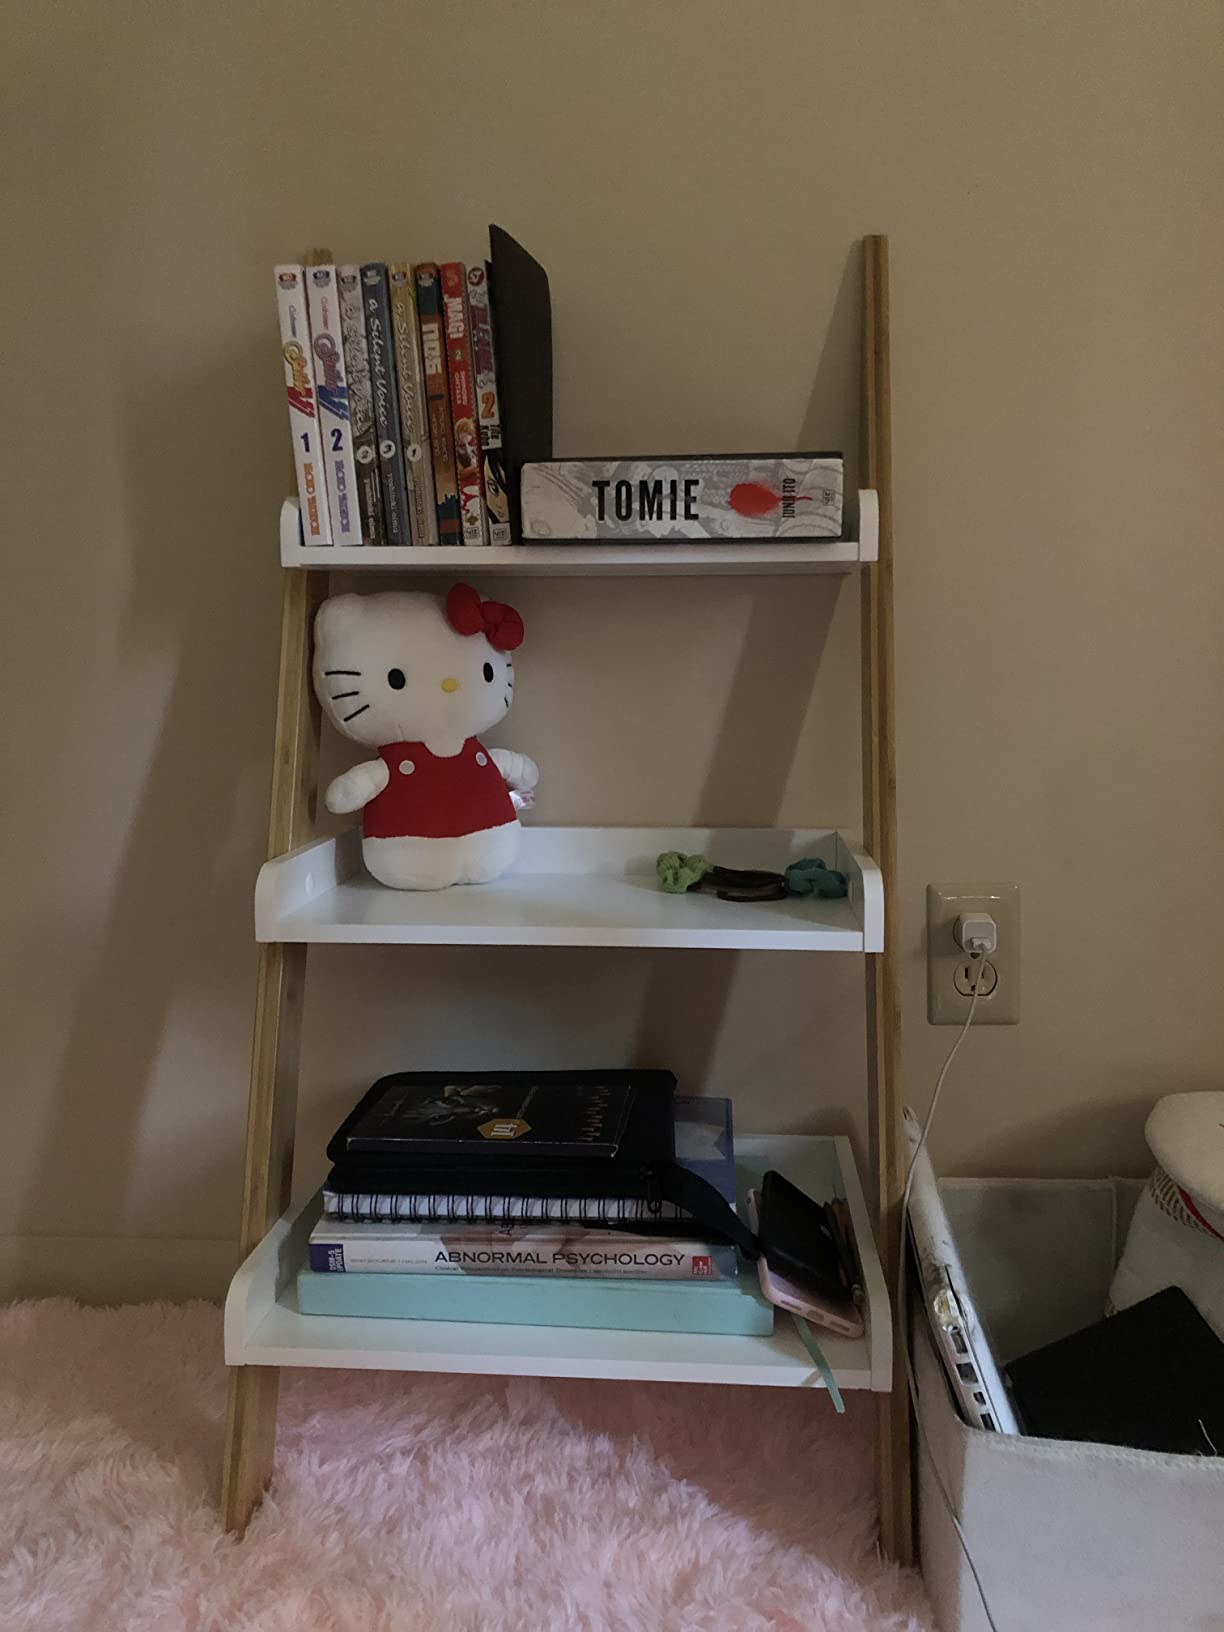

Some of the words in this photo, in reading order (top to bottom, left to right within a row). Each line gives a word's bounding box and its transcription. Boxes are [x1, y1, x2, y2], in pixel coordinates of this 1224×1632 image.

[368, 299, 379, 313] a
[444, 295, 465, 340] MAGI
[369, 317, 387, 378] Silent
[375, 381, 389, 428] Voice
[480, 391, 496, 420] 2
[300, 431, 311, 452] 1
[330, 428, 343, 452] 2
[782, 478, 796, 494] ITO
[592, 480, 700, 521] TOMIE
[434, 1251, 548, 1265] ABNORMAL
[552, 1252, 686, 1267] PSYCHOLOGY
